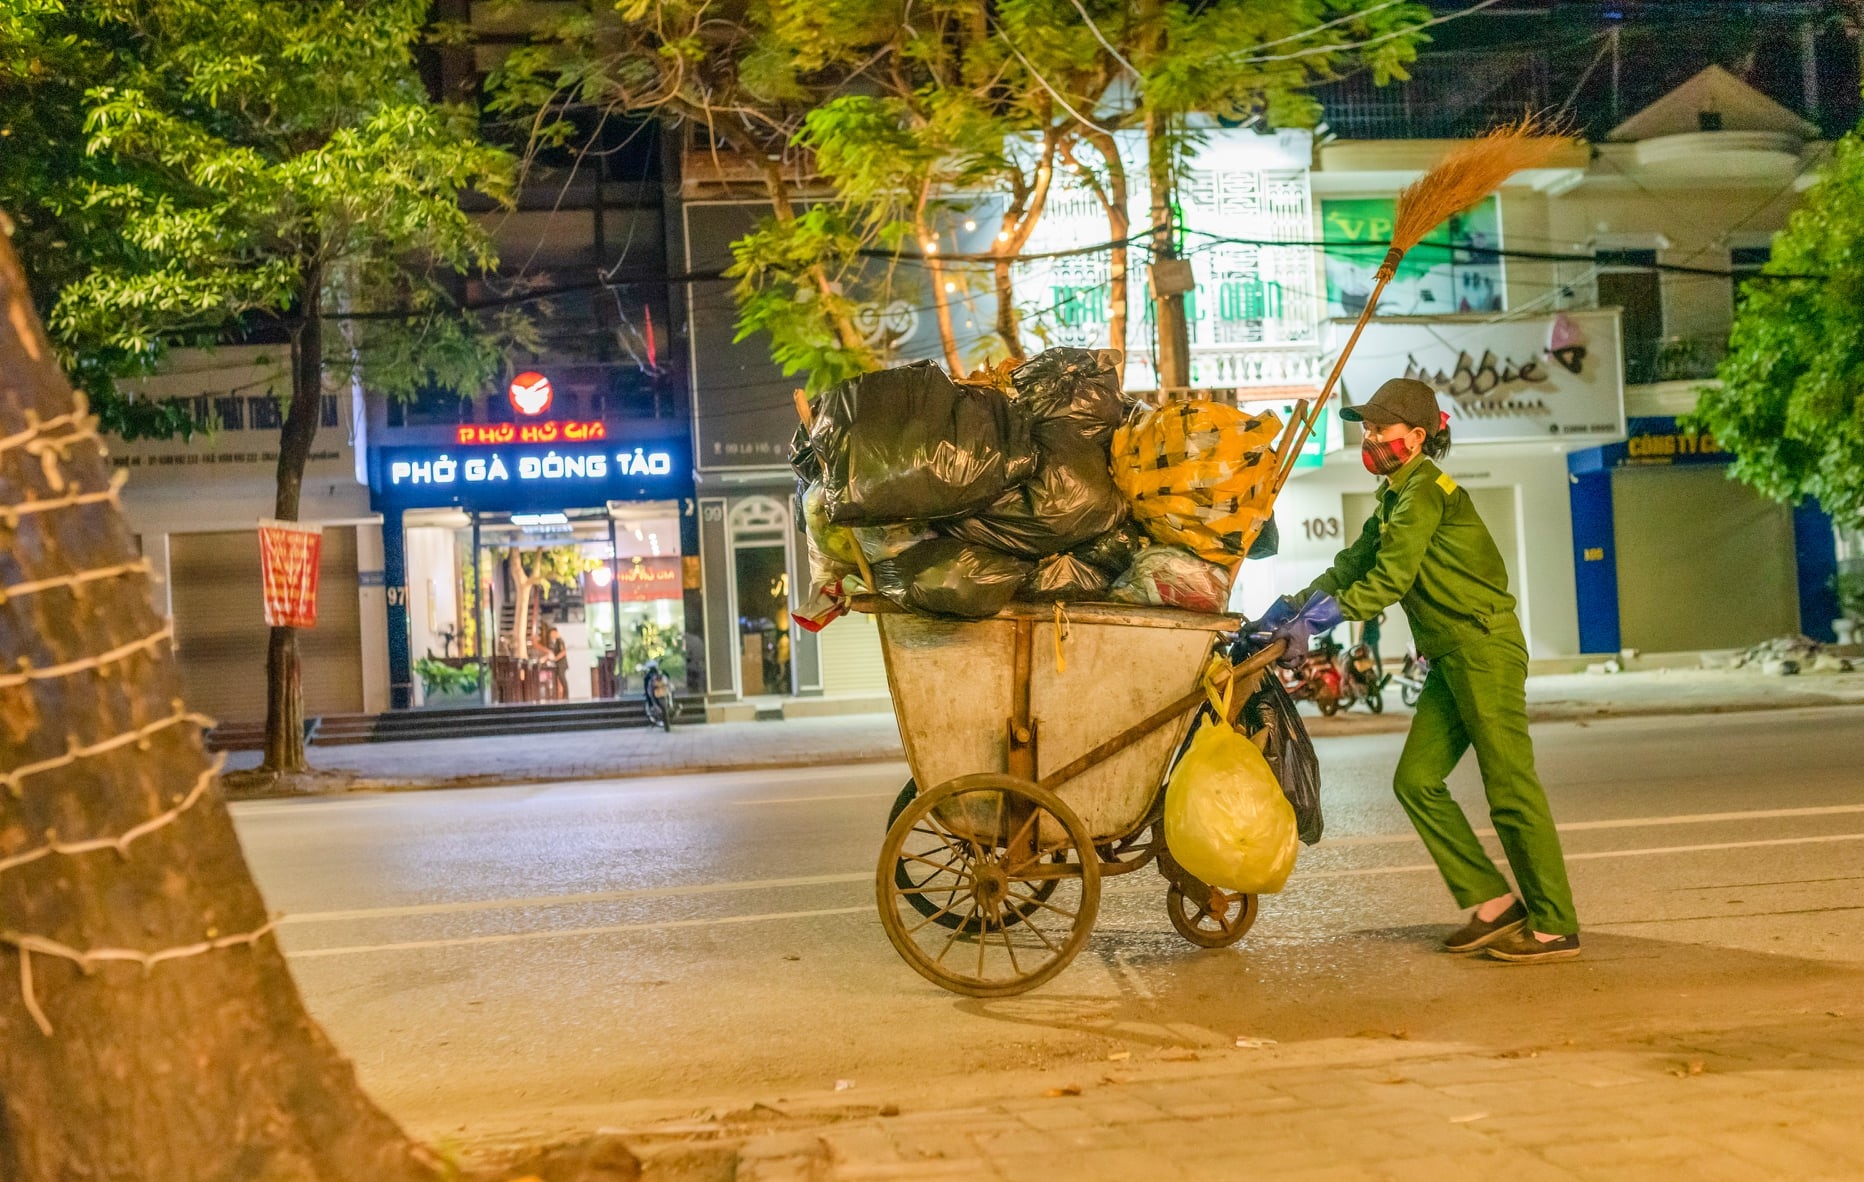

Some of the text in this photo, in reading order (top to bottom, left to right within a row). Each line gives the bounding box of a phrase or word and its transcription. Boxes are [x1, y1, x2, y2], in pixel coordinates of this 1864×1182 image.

[391, 454, 457, 485] PHỞ
[465, 453, 509, 481] GÀ
[704, 506, 722, 522] 99
[1302, 516, 1339, 541] 103
[387, 586, 405, 606] 97
